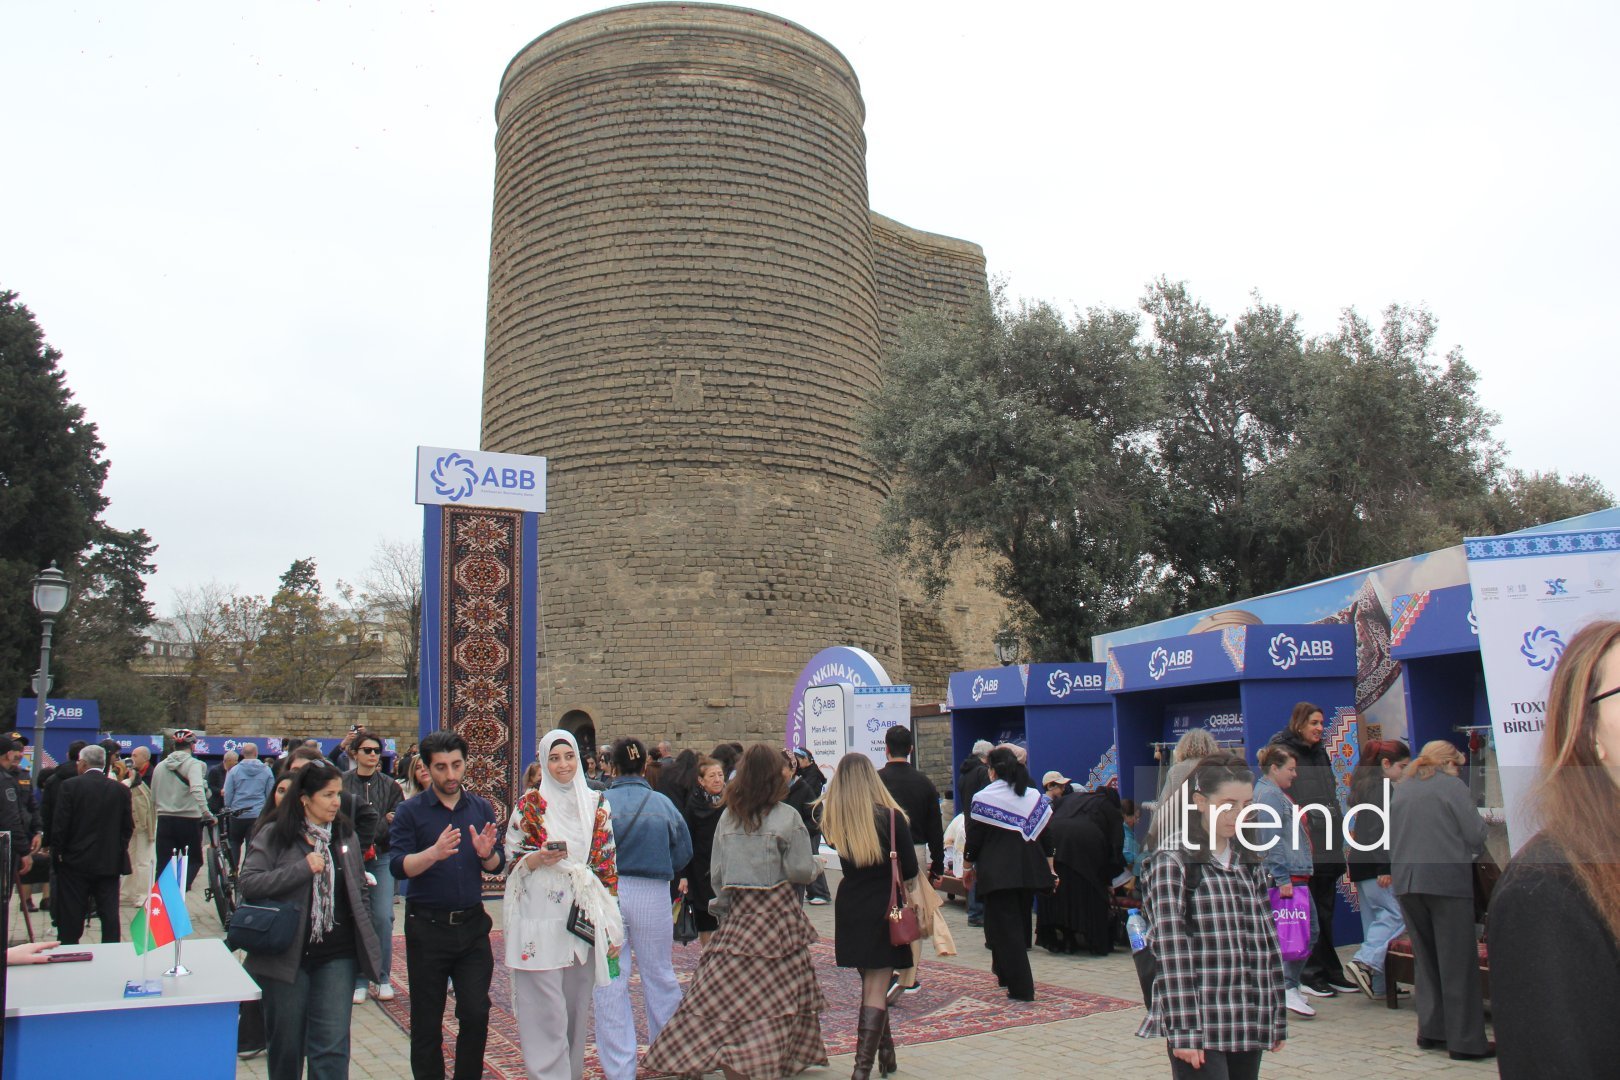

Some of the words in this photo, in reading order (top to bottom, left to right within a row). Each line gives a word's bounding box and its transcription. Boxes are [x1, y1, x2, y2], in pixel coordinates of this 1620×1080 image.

[481, 466, 536, 490] ABB
[1299, 640, 1334, 656] ABB
[1168, 649, 1193, 667] ABB
[983, 679, 999, 692] ABB
[1073, 675, 1102, 688] ABB
[822, 699, 836, 709] ABB
[57, 707, 83, 717] ABB
